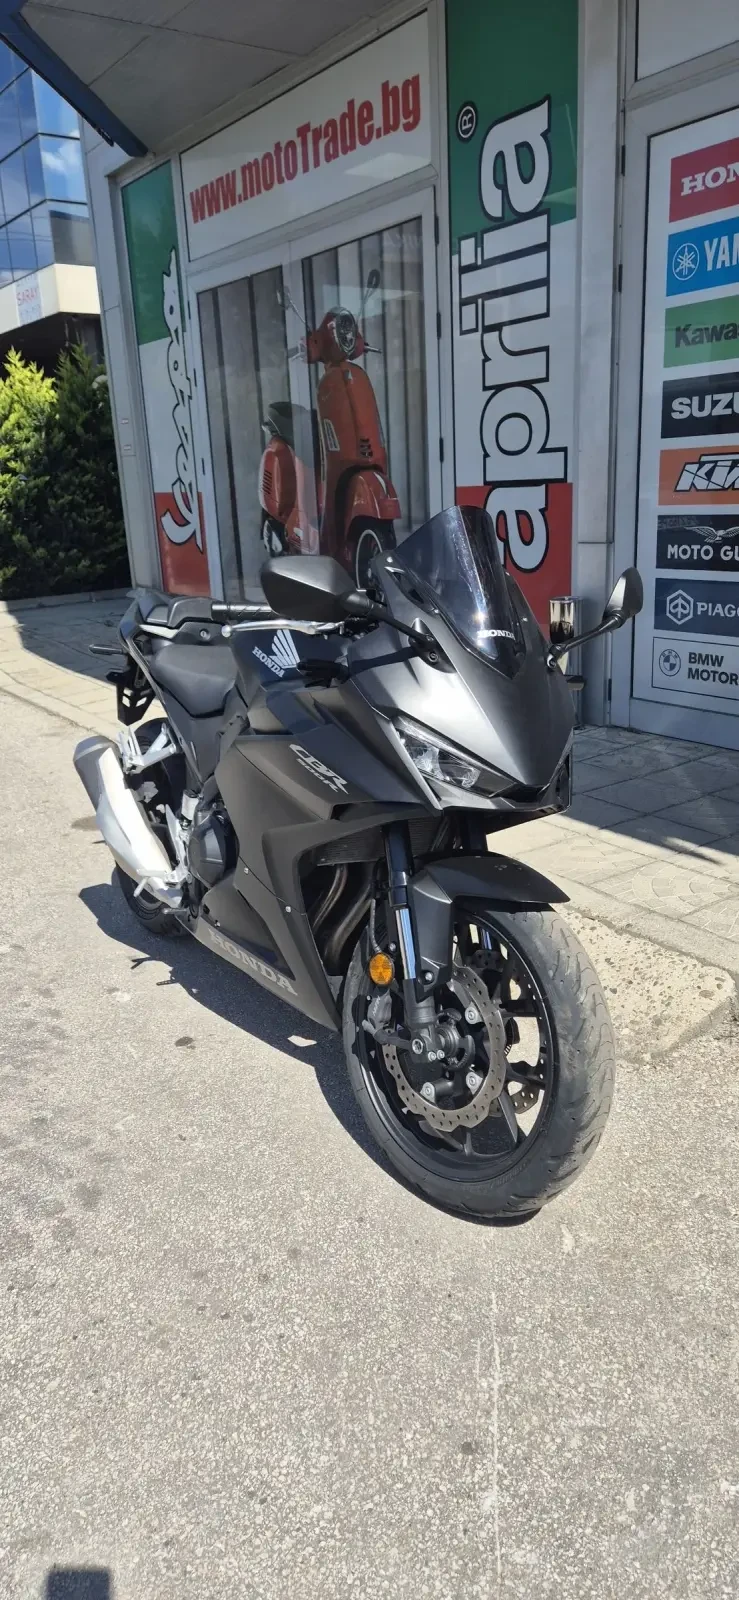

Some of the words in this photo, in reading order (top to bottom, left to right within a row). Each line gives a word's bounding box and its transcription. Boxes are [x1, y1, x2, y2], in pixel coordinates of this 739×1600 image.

[189, 74, 421, 224] www.motoTrade.bg
[459, 95, 568, 573] aprilia
[675, 322, 739, 349] Kawa
[667, 544, 714, 560] MOTO
[696, 601, 739, 618] PIAG
[252, 646, 286, 678] HONDA
[688, 652, 724, 668] BMW
[687, 667, 739, 686] MOTOR
[289, 743, 349, 794] CBR
[207, 927, 298, 996] HONDA
